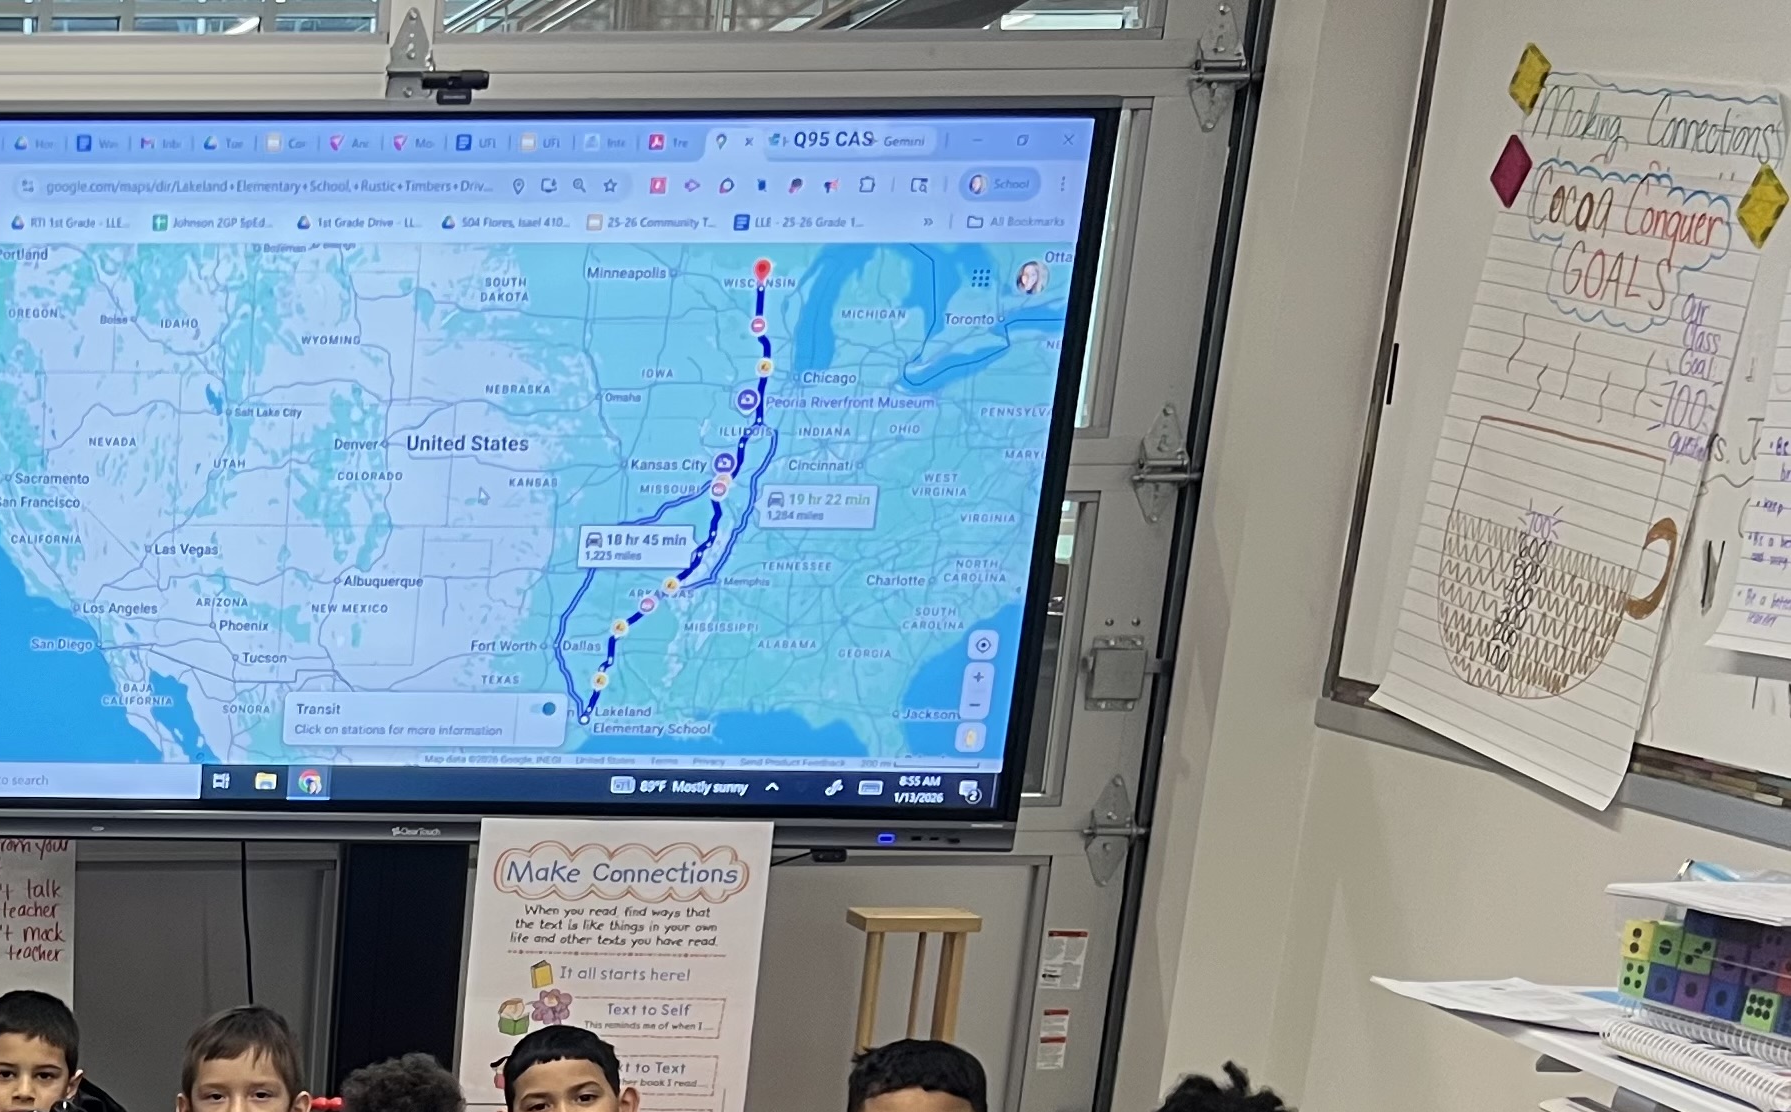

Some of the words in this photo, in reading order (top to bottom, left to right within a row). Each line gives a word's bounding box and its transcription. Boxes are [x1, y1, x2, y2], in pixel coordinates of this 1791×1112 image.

[1531, 85, 1629, 163] Making
[1647, 92, 1773, 165] Connections
[793, 131, 830, 148] Q95
[835, 130, 875, 147] CAS
[883, 135, 926, 148] Gemini
[993, 178, 1030, 190] School
[1531, 165, 1614, 239] Cocoa
[1624, 173, 1724, 273] Conquer
[586, 266, 667, 282] Minneapolis
[1562, 240, 1672, 311] GOALS
[944, 313, 995, 327] Toronto
[1683, 322, 1722, 354] Class
[640, 368, 674, 379] IOWA
[802, 371, 857, 388] Chicago
[765, 396, 807, 410] Peoria
[810, 396, 876, 410] Riverfront
[878, 396, 935, 410] Museum
[234, 407, 257, 418] Salt
[259, 407, 281, 418] Lake
[282, 407, 303, 419] City
[87, 436, 137, 448] NEVADA
[334, 437, 379, 451] Denver
[406, 434, 467, 453] United
[470, 435, 530, 453] States
[212, 458, 247, 470] UTAH
[630, 459, 679, 472] Kansas
[681, 459, 708, 474] City
[787, 458, 854, 473] Cincinnati
[14, 472, 90, 486] Sacramento
[336, 470, 404, 482] COLORADO
[19, 496, 81, 510] Francisco
[10, 533, 83, 546] CALIFORNIA
[606, 533, 624, 547] 18
[626, 533, 640, 547] hr
[642, 533, 660, 547] 45
[662, 533, 687, 547] min
[344, 574, 425, 590] Albuquerque
[865, 574, 927, 588] Charlotte
[82, 602, 105, 615] Los
[109, 602, 158, 617] Angeles
[218, 619, 270, 633] Phoenix
[242, 651, 288, 664] Tucson
[594, 706, 652, 718] Lakeland
[593, 723, 665, 737] Elementary
[667, 722, 711, 735] School
[11, 774, 50, 787] search
[671, 779, 712, 796] Mostly
[712, 782, 750, 797] sunny
[899, 775, 921, 788] 8:55
[921, 775, 942, 788] AM
[893, 791, 945, 804] 1/13/2026
[36, 838, 71, 861] your
[506, 860, 581, 885] Make
[592, 861, 739, 885] Connections
[26, 880, 62, 899] talk
[1, 900, 60, 920] teacher
[524, 903, 560, 917] When
[564, 906, 585, 920] you
[623, 905, 647, 918] find
[651, 907, 682, 921] ways
[686, 905, 711, 919] that
[21, 922, 66, 943] mock
[515, 918, 535, 931] the
[539, 918, 563, 931] text
[567, 918, 579, 931] is
[582, 918, 605, 932] like
[609, 919, 645, 934] things
[648, 920, 660, 933] in
[664, 923, 691, 935] your
[695, 923, 718, 933] own
[510, 931, 529, 944] life
[534, 932, 556, 945] and
[560, 933, 593, 945] other
[597, 934, 627, 947] texts
[631, 936, 652, 949] you
[655, 935, 684, 947] have
[8, 943, 66, 963] teacher
[559, 965, 573, 980] It
[577, 966, 597, 981] all
[600, 966, 646, 982] starts
[649, 968, 692, 983] here!
[607, 1003, 639, 1017] Text
[641, 1004, 658, 1017] to
[660, 1002, 694, 1018] Self
